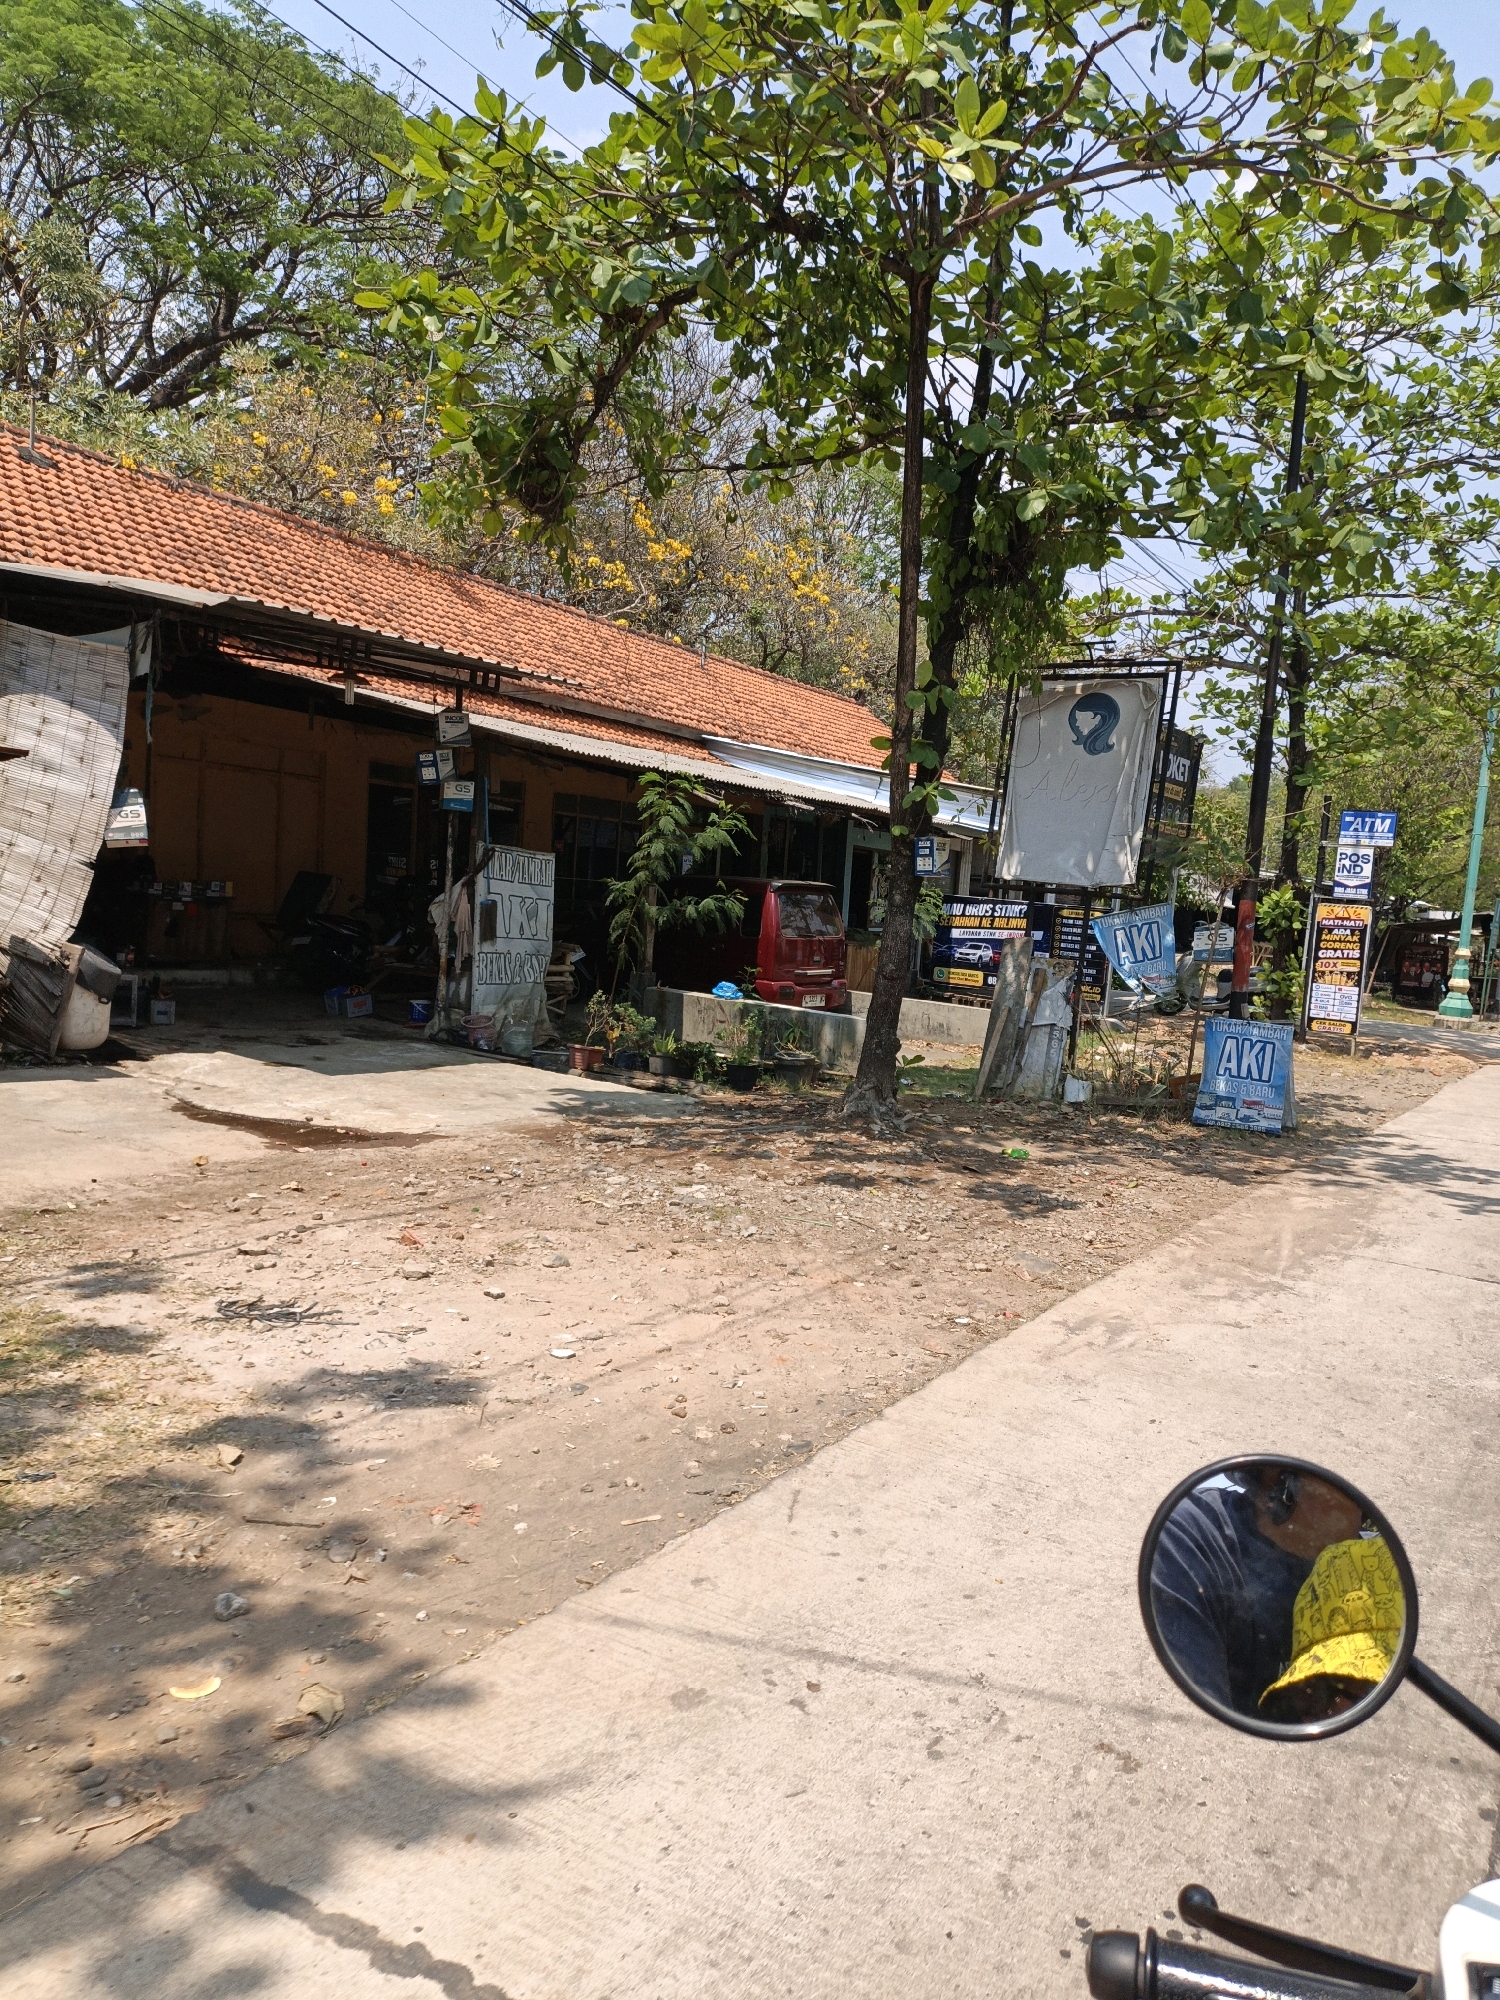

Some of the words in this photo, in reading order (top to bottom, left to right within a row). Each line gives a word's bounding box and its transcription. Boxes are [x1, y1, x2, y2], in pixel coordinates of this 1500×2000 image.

[454, 783, 471, 794] GS
[119, 809, 141, 819] GS
[1348, 817, 1392, 833] ATM
[1338, 852, 1371, 865] POS
[965, 904, 994, 917] URUS
[994, 904, 1028, 917] STNK?
[940, 916, 981, 927] SERAHKAN
[981, 917, 992, 928] KE
[992, 917, 1028, 929] AHLINYA
[1321, 919, 1363, 927] HATI-HATI
[1114, 920, 1162, 967] AKI
[1321, 934, 1360, 942] MINYAK
[1320, 941, 1360, 950] GORENG
[1318, 950, 1360, 958] GRATIS
[477, 952, 511, 985] BEKAS
[513, 952, 522, 984] &
[1147, 961, 1167, 974] BARU
[1216, 1036, 1276, 1083] AKI
[1210, 1079, 1240, 1094] BEKAS
[1240, 1082, 1248, 1095] &
[1249, 1084, 1276, 1099] BARU
